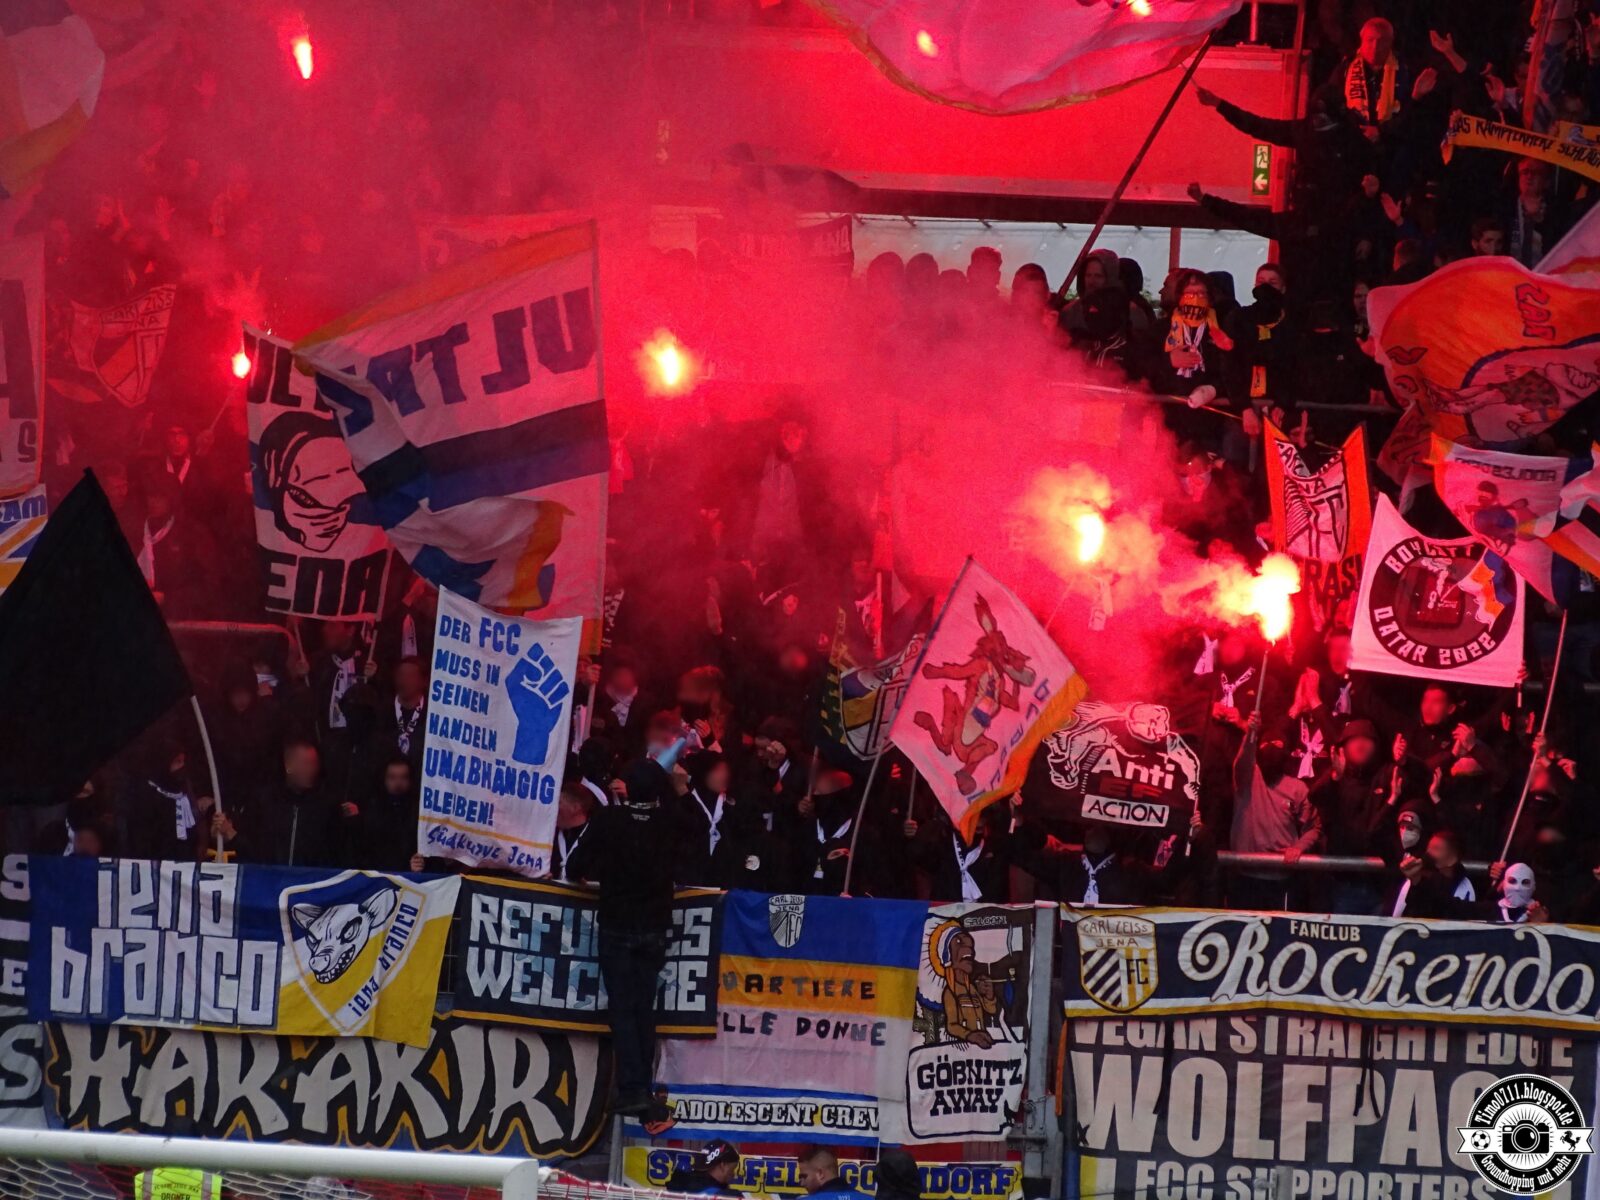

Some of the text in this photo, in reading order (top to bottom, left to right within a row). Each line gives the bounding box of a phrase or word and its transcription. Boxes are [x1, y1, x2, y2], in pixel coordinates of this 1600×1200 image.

[439, 614, 521, 656] DER FCC
[1374, 605, 1496, 665] QATAR 2022
[434, 648, 501, 687] MUSS IN
[431, 679, 490, 716] SEINEN
[428, 712, 497, 752] HANDELN
[425, 747, 556, 805] UNABHÄNGIG
[1091, 747, 1176, 790] Anti
[423, 786, 494, 827] BLEIBEN!
[1088, 799, 1166, 824] ACTION
[1083, 918, 1148, 934] CARL ZEISS
[1096, 938, 1138, 948] JENA
[1290, 919, 1361, 942] FANCLUB
[50, 926, 279, 1027] branco
[466, 946, 708, 1011] WELCME
[722, 971, 876, 999] UARTIERE
[1126, 958, 1149, 984] FC
[1177, 915, 1600, 1016] Rockendo
[796, 1016, 887, 1046] DONNE
[917, 1054, 1023, 1091] GÖBNITZ
[672, 1098, 819, 1128] ADOLESCENT
[929, 1088, 1007, 1117] AWAY
[1070, 1050, 1574, 1172] WOLFPAC
[1135, 1159, 1214, 1200] FCC
